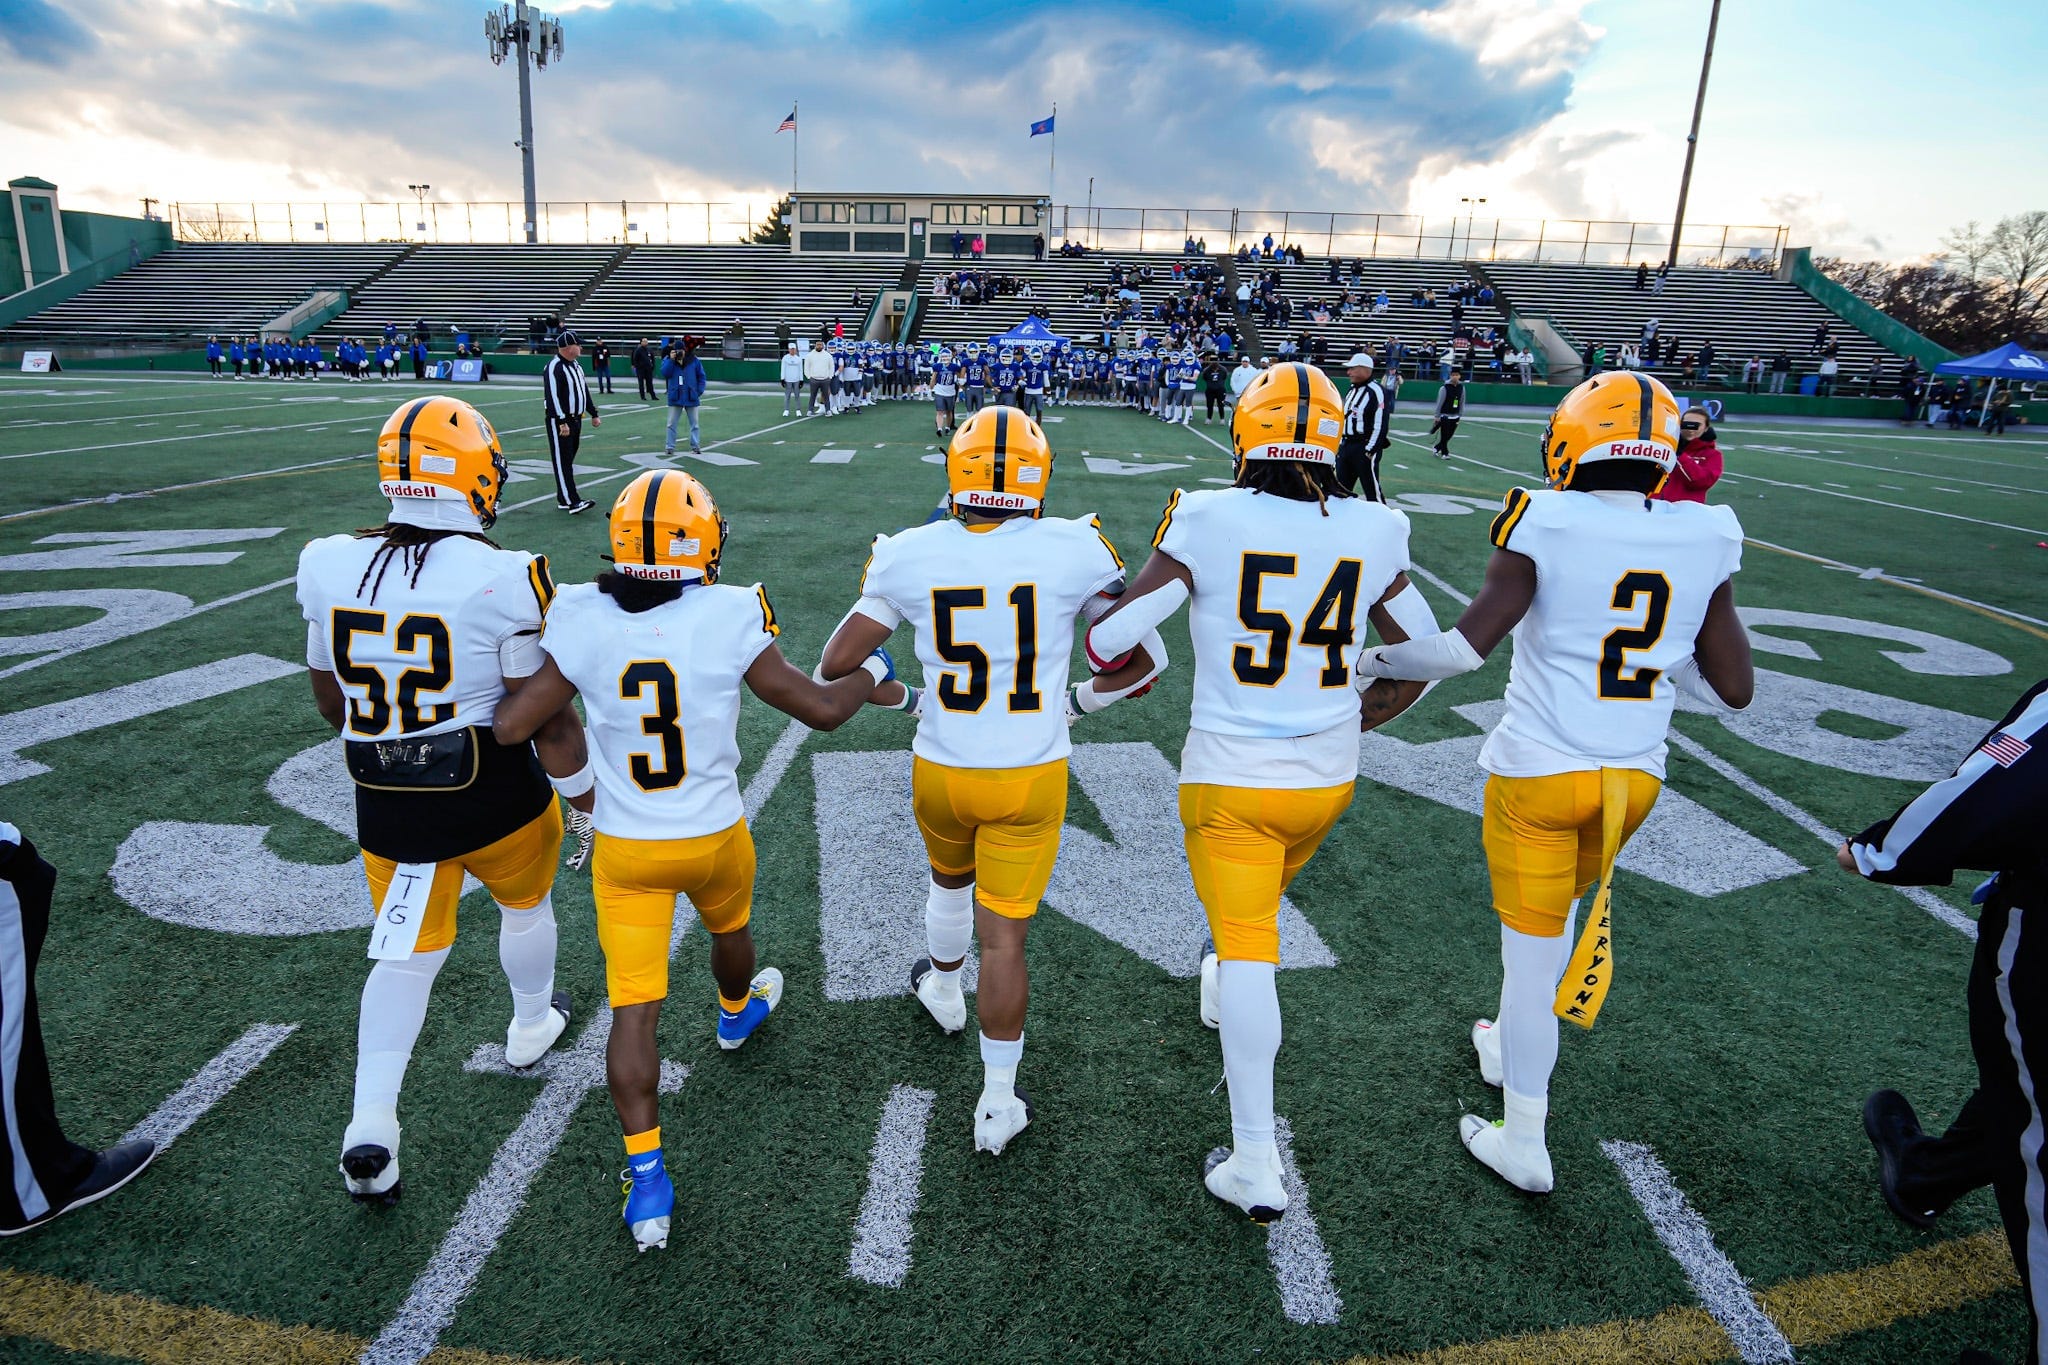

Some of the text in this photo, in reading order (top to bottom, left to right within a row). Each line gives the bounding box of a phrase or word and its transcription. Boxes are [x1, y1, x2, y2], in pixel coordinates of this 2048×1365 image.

[383, 484, 437, 498] Riddell
[968, 492, 1025, 509] Riddell
[1266, 446, 1325, 461] Riddell
[1609, 443, 1671, 462] Riddell
[623, 566, 682, 580] Riddell
[1231, 551, 1364, 690] 54
[1597, 568, 1673, 701] 2
[331, 606, 457, 737] 52
[930, 582, 1043, 714] 51
[618, 658, 687, 794] 3
[1565, 885, 1612, 1020] VERYONE
